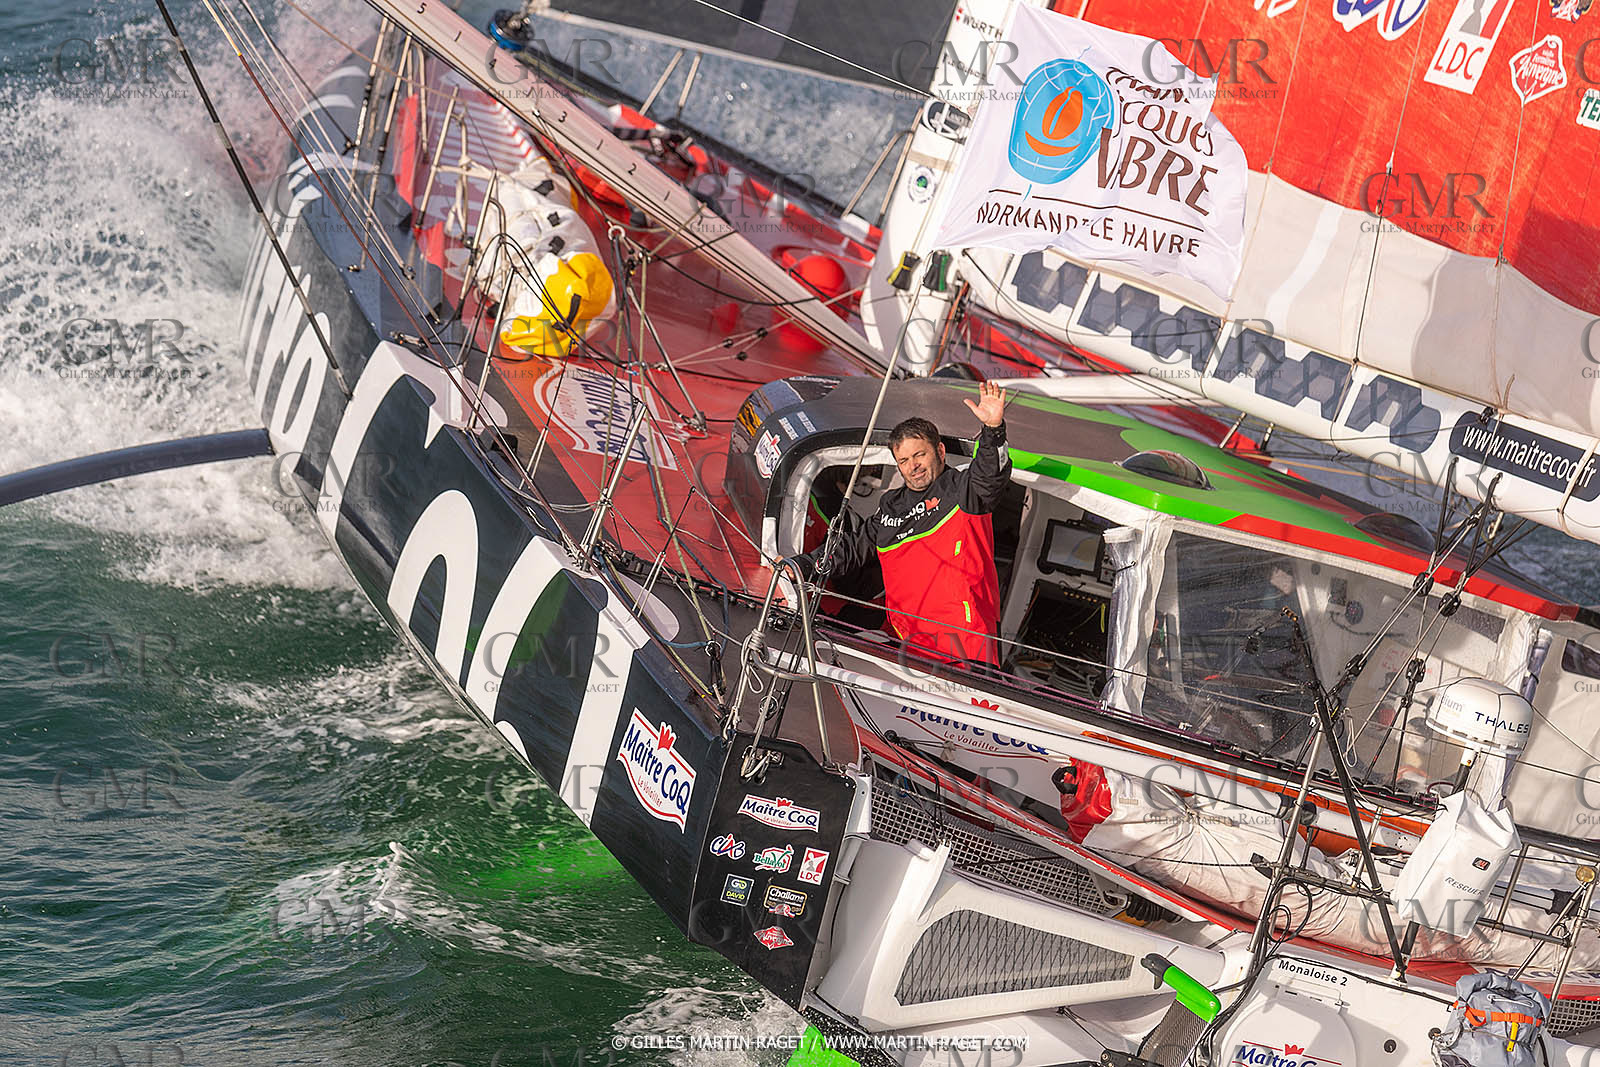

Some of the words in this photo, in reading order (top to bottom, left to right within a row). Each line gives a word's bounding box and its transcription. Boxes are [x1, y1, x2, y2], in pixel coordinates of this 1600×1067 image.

[558, 111, 567, 123] 3
[628, 163, 637, 176] 2
[1122, 222, 1200, 257] HAVRE
[1462, 425, 1597, 488] www.maitrecoqfr
[943, 729, 955, 739] Le
[957, 735, 999, 752] Volailler
[623, 723, 662, 783] Maître
[661, 764, 690, 815] CoQ
[742, 800, 786, 818] Maître
[788, 810, 818, 826] CoQ
[800, 871, 820, 882] LDC
[726, 890, 745, 900] DAVID
[1278, 959, 1338, 984] Monaloise
[1341, 976, 1348, 987] 2
[1236, 1045, 1298, 1067] Maître
